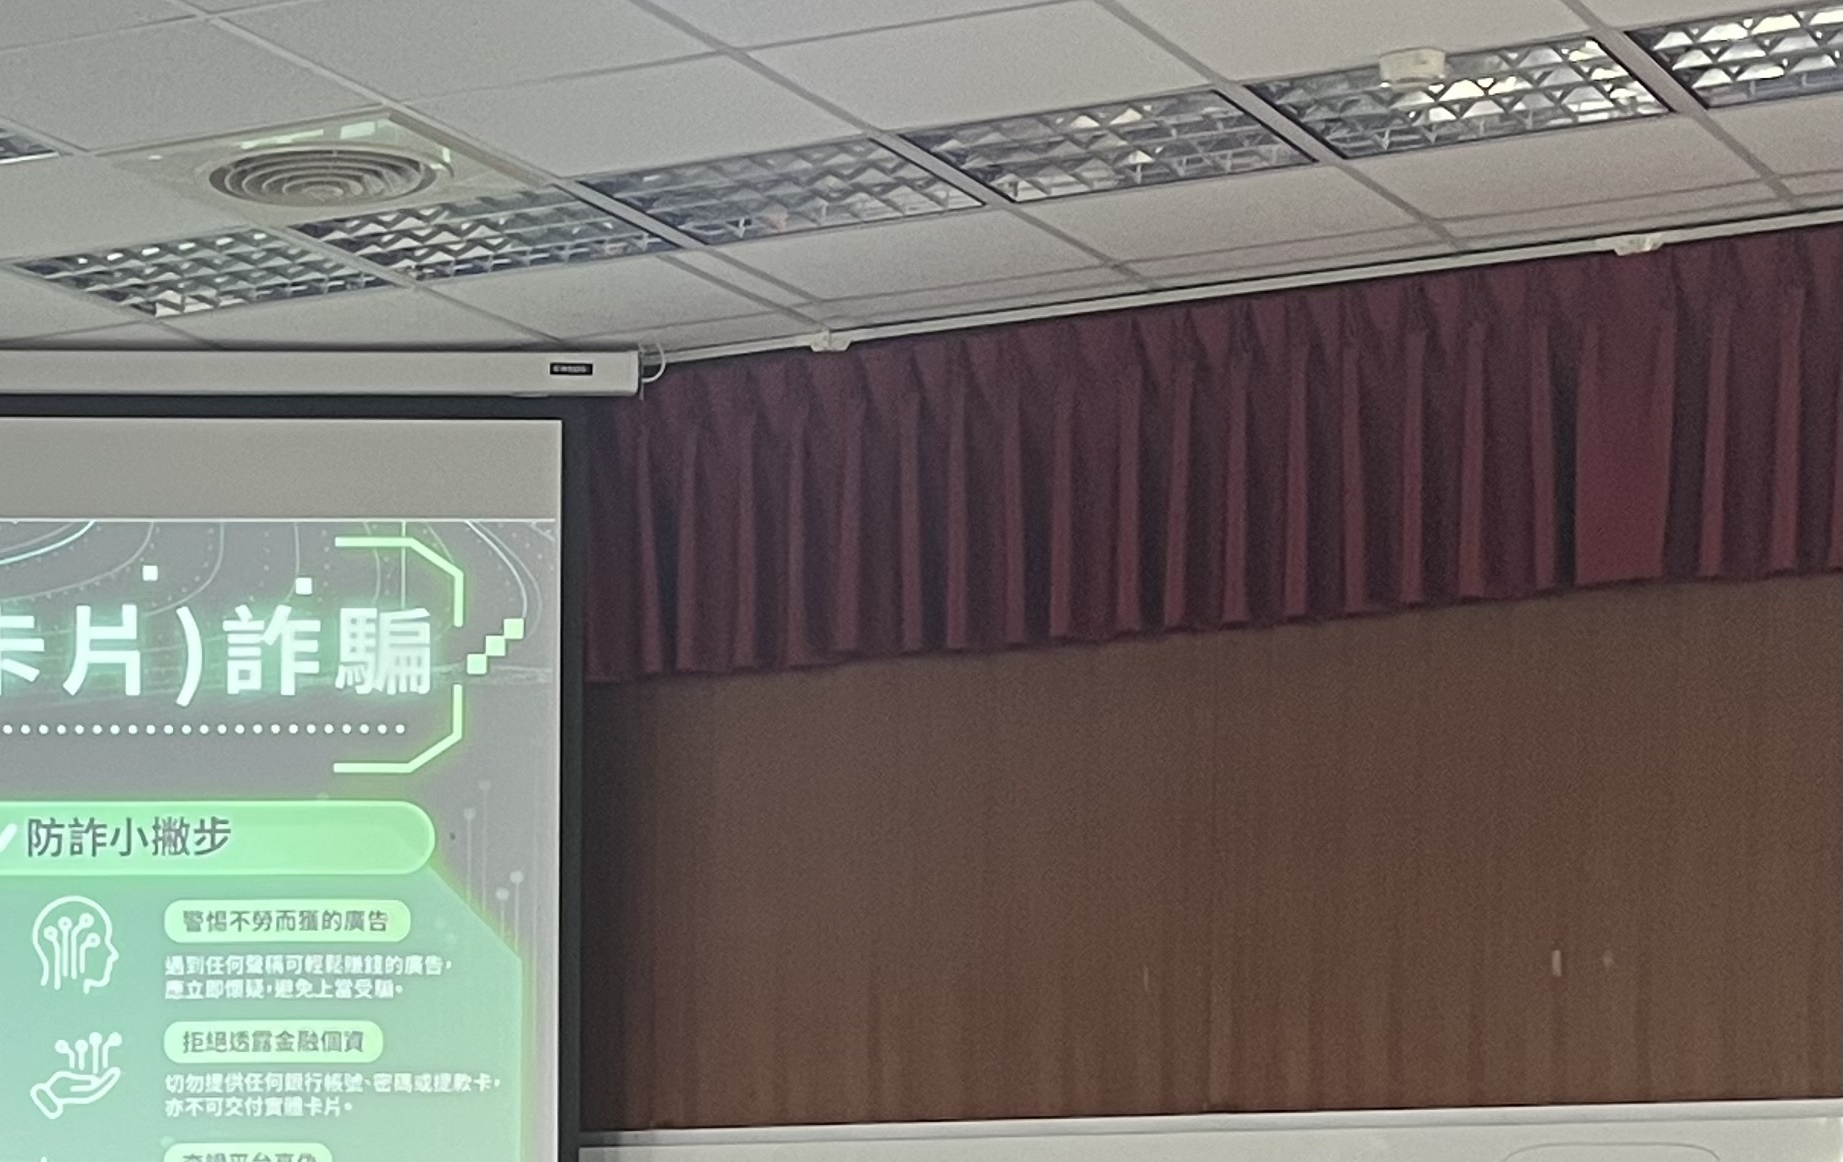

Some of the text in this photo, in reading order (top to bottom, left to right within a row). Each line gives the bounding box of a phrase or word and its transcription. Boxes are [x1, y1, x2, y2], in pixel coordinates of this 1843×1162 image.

[27, 816, 232, 857] 防詐小撇步
[183, 910, 389, 932] 警惕不勞而獲的廣告
[182, 1030, 365, 1054] 拒絕透露金融個資
